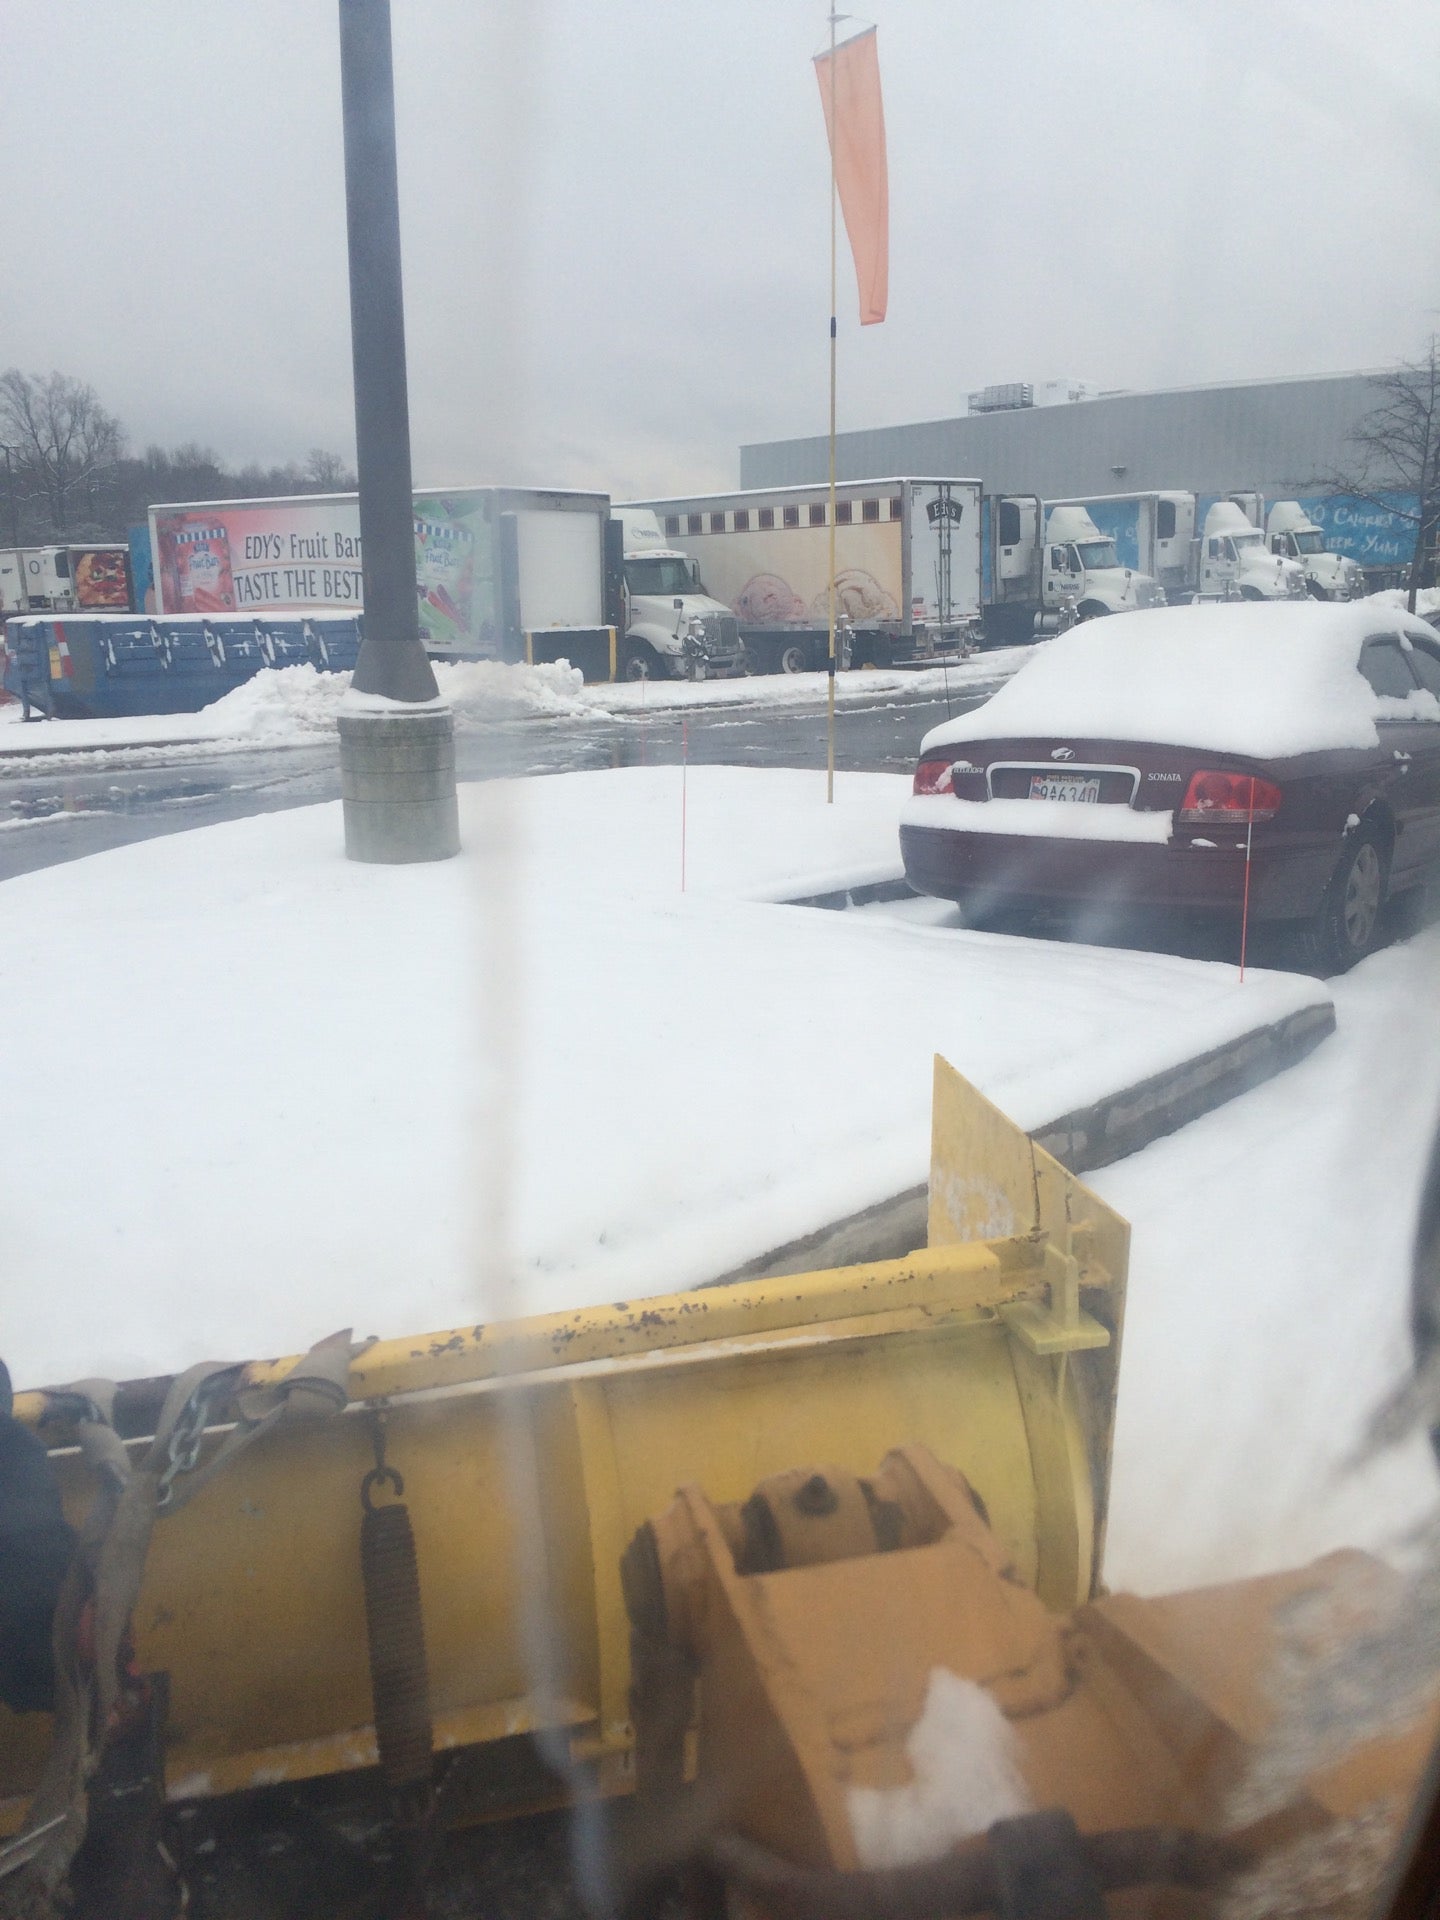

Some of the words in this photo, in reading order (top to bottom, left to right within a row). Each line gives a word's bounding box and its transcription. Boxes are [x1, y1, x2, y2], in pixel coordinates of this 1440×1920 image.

[245, 533, 281, 559] EDY'S
[290, 532, 329, 559] Fruit
[1360, 535, 1399, 556] YUM
[234, 571, 281, 602] TASTE
[284, 570, 317, 598] THE
[323, 570, 363, 600] BEST
[1148, 772, 1182, 782] SONATA
